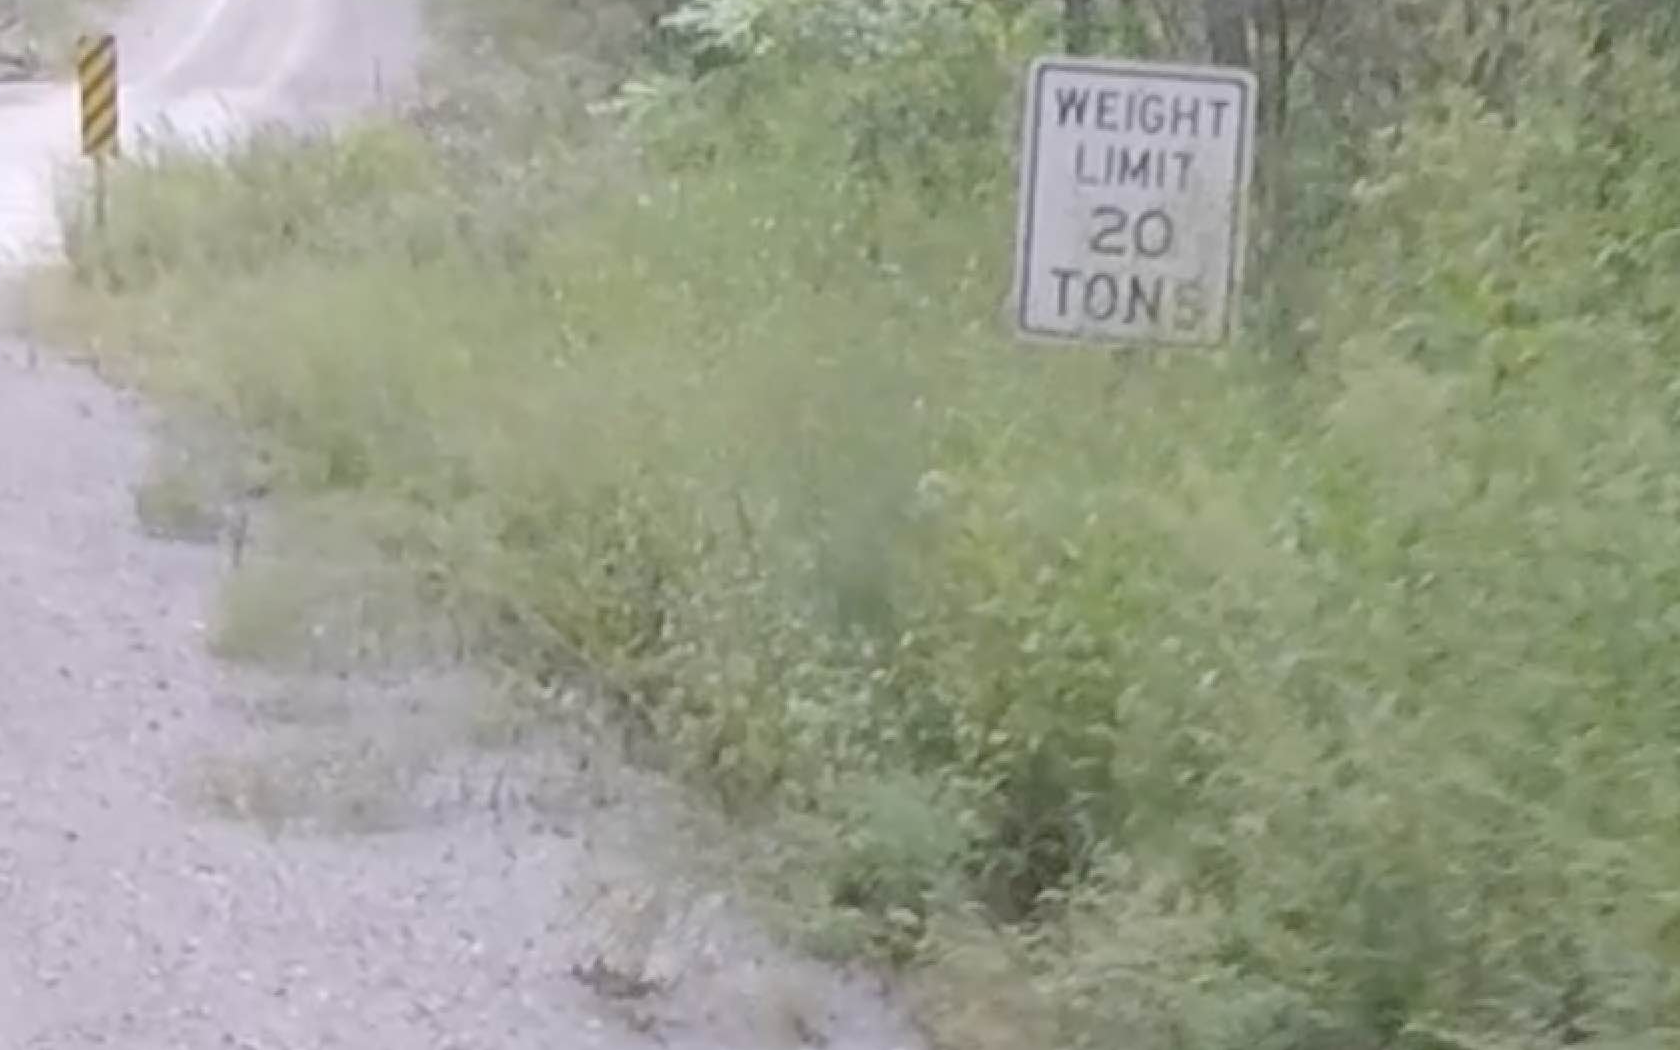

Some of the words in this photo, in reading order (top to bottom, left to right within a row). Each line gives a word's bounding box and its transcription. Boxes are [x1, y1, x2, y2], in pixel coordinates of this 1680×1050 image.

[1055, 87, 1230, 137] WEIGHT
[1075, 143, 1195, 191] LIMIT
[1089, 206, 1172, 258] 20
[1050, 267, 1206, 331] TONS
